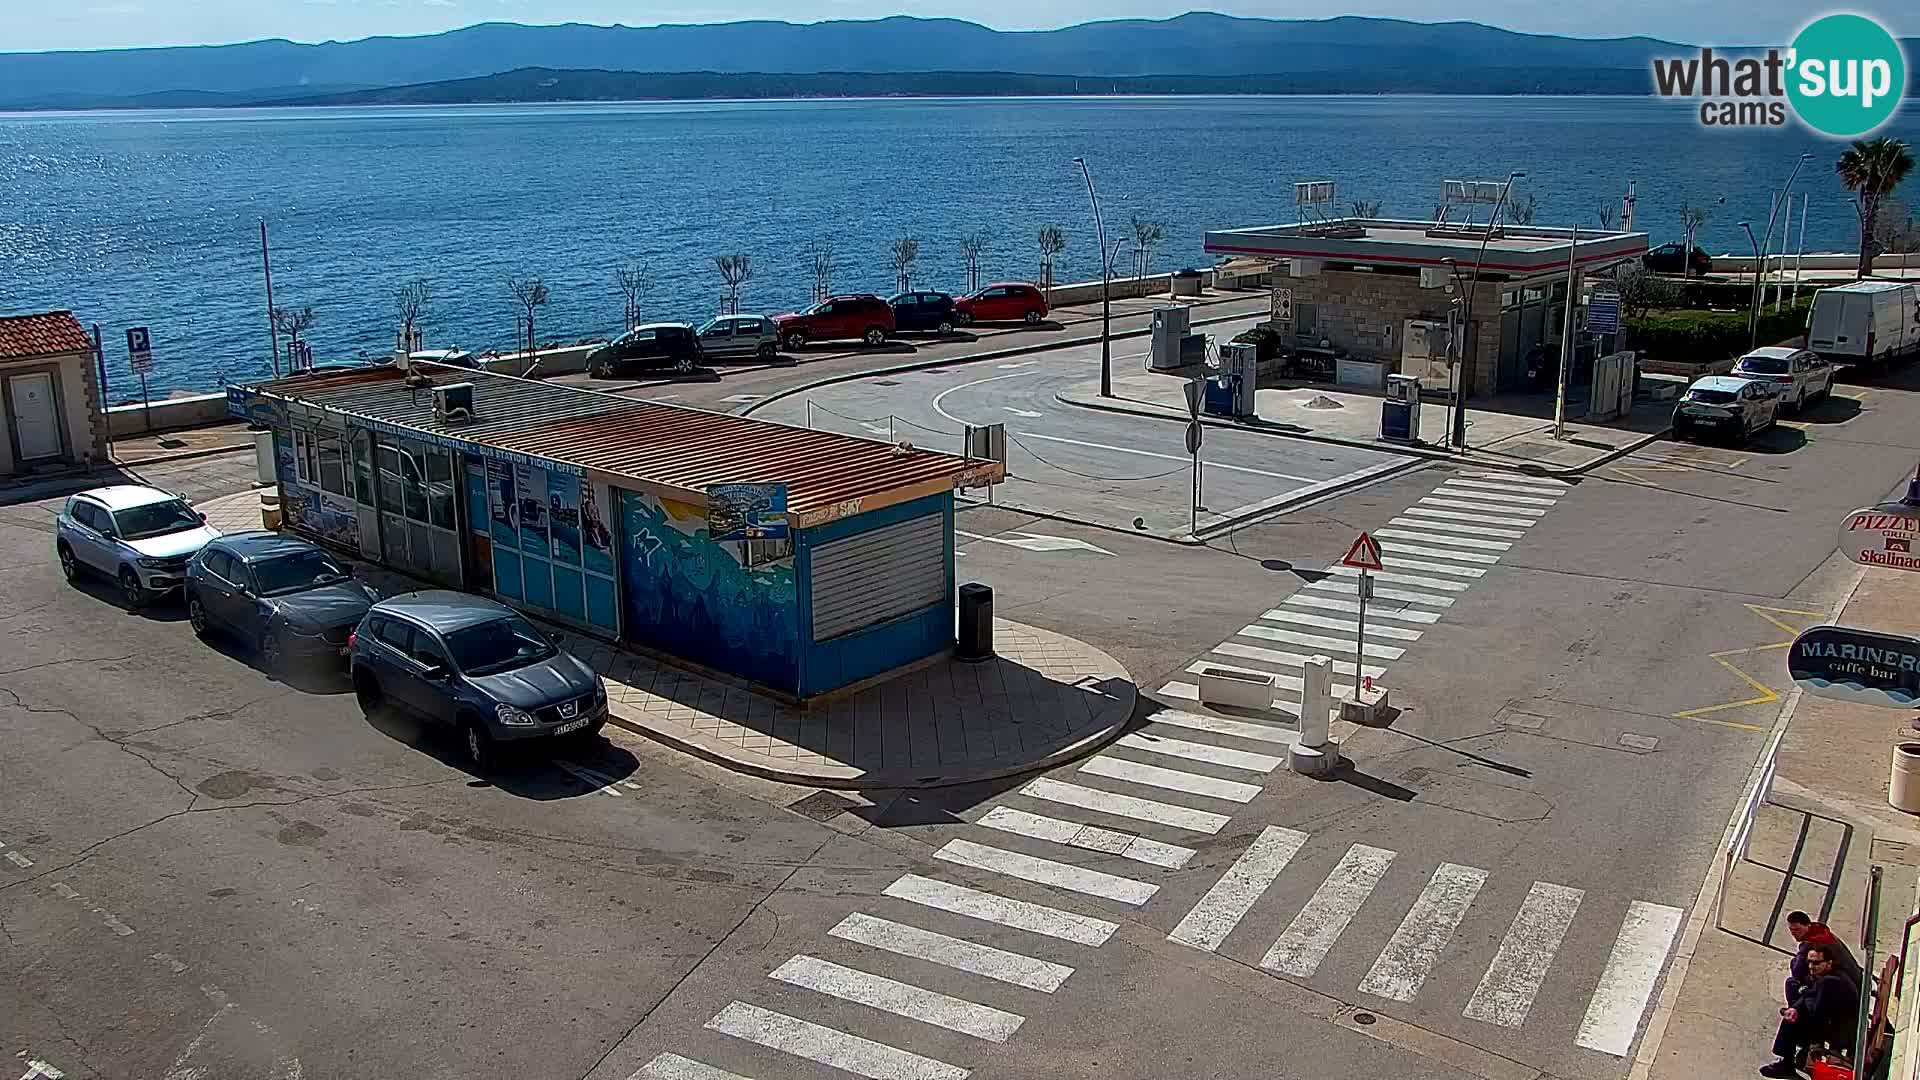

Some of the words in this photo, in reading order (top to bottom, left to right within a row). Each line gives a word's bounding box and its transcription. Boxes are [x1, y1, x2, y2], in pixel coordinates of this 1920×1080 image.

[132, 331, 144, 349] P
[480, 446, 494, 457] BUS
[495, 449, 527, 464] STATION
[529, 456, 555, 471] TICKET
[556, 464, 583, 477] OFFICE
[1848, 515, 1920, 533] PIZZE
[1800, 642, 1920, 673] MARINER
[1829, 662, 1866, 675] caffe
[1870, 665, 1897, 679] bar
